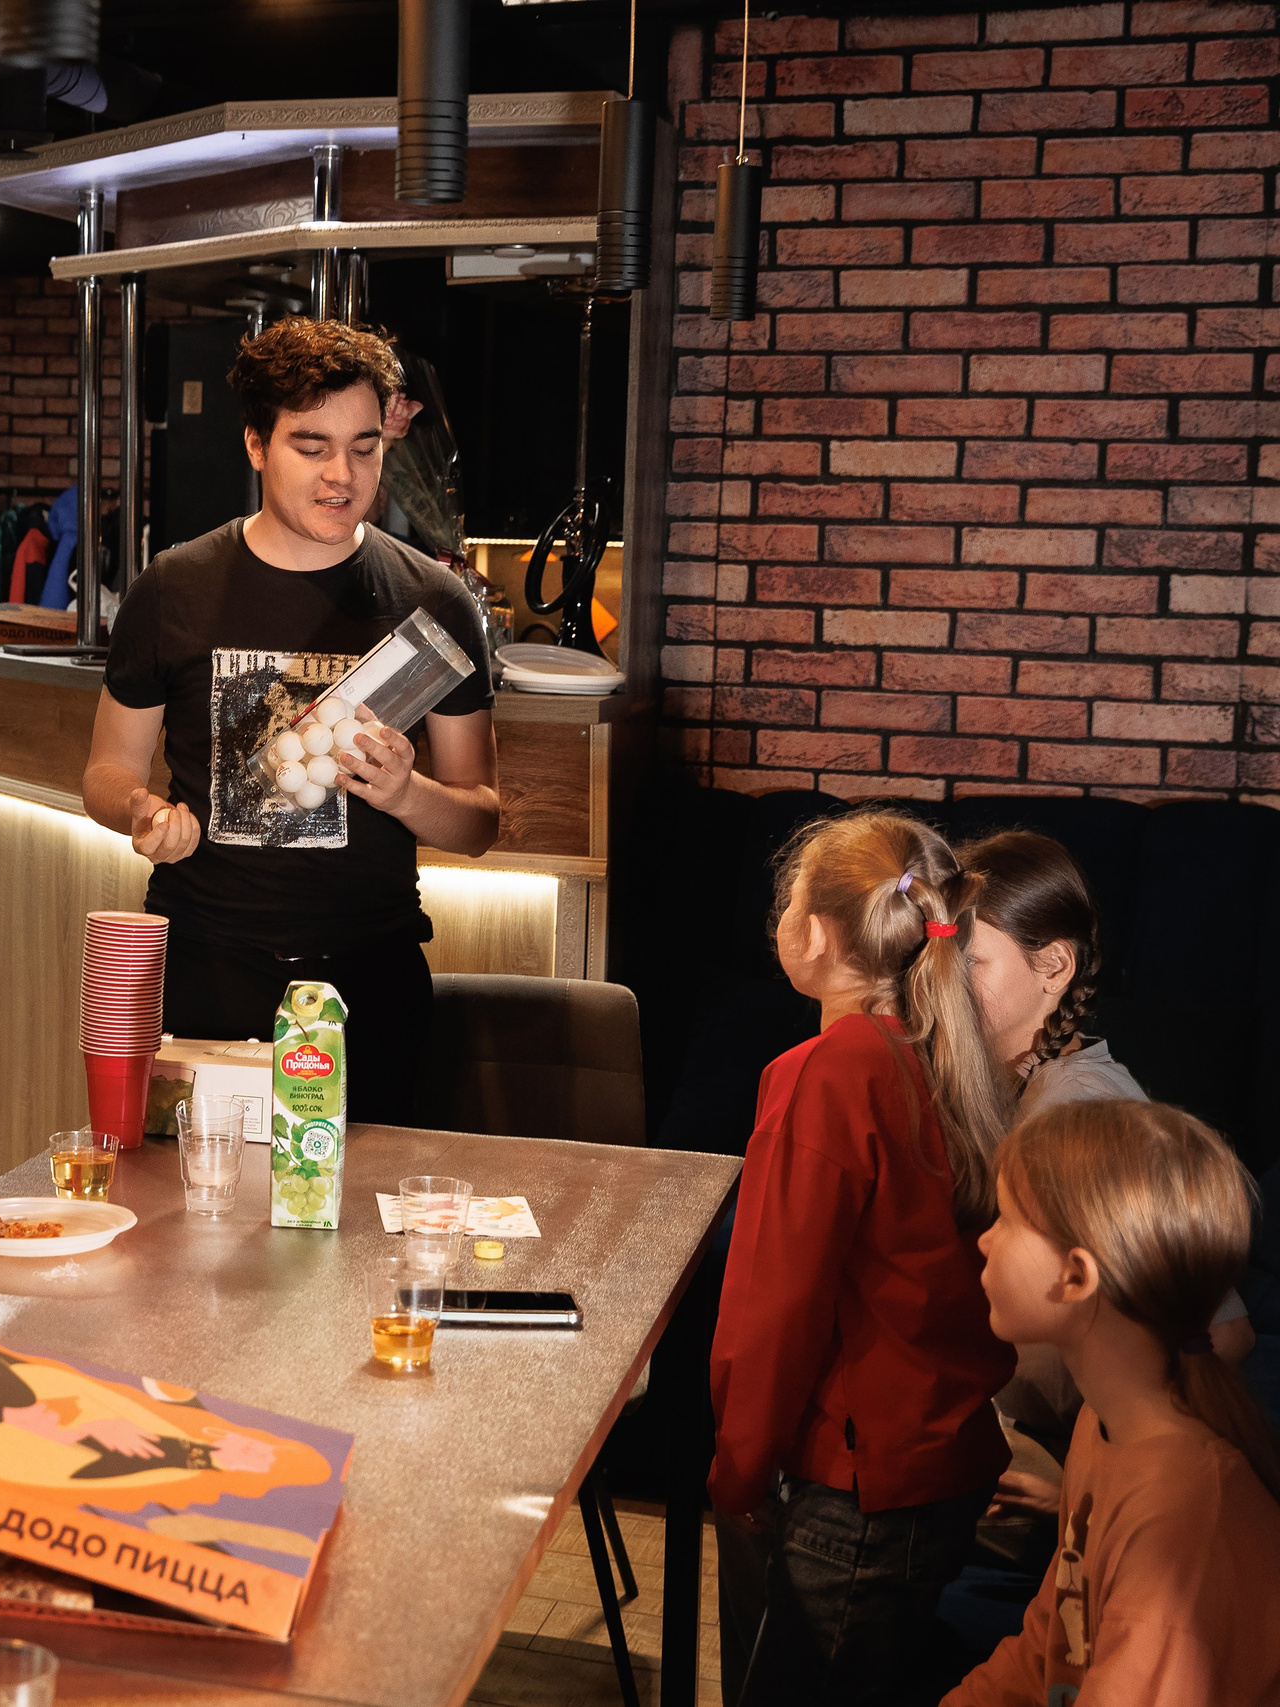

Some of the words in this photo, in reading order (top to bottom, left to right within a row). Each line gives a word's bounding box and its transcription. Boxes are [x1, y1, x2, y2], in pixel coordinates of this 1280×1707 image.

[295, 1052, 320, 1062] Сады
[285, 1059, 330, 1071] Придонья
[292, 1104, 308, 1113] 100%
[309, 1104, 323, 1113] СОК
[114, 1541, 251, 1606] ПИЦЦА
